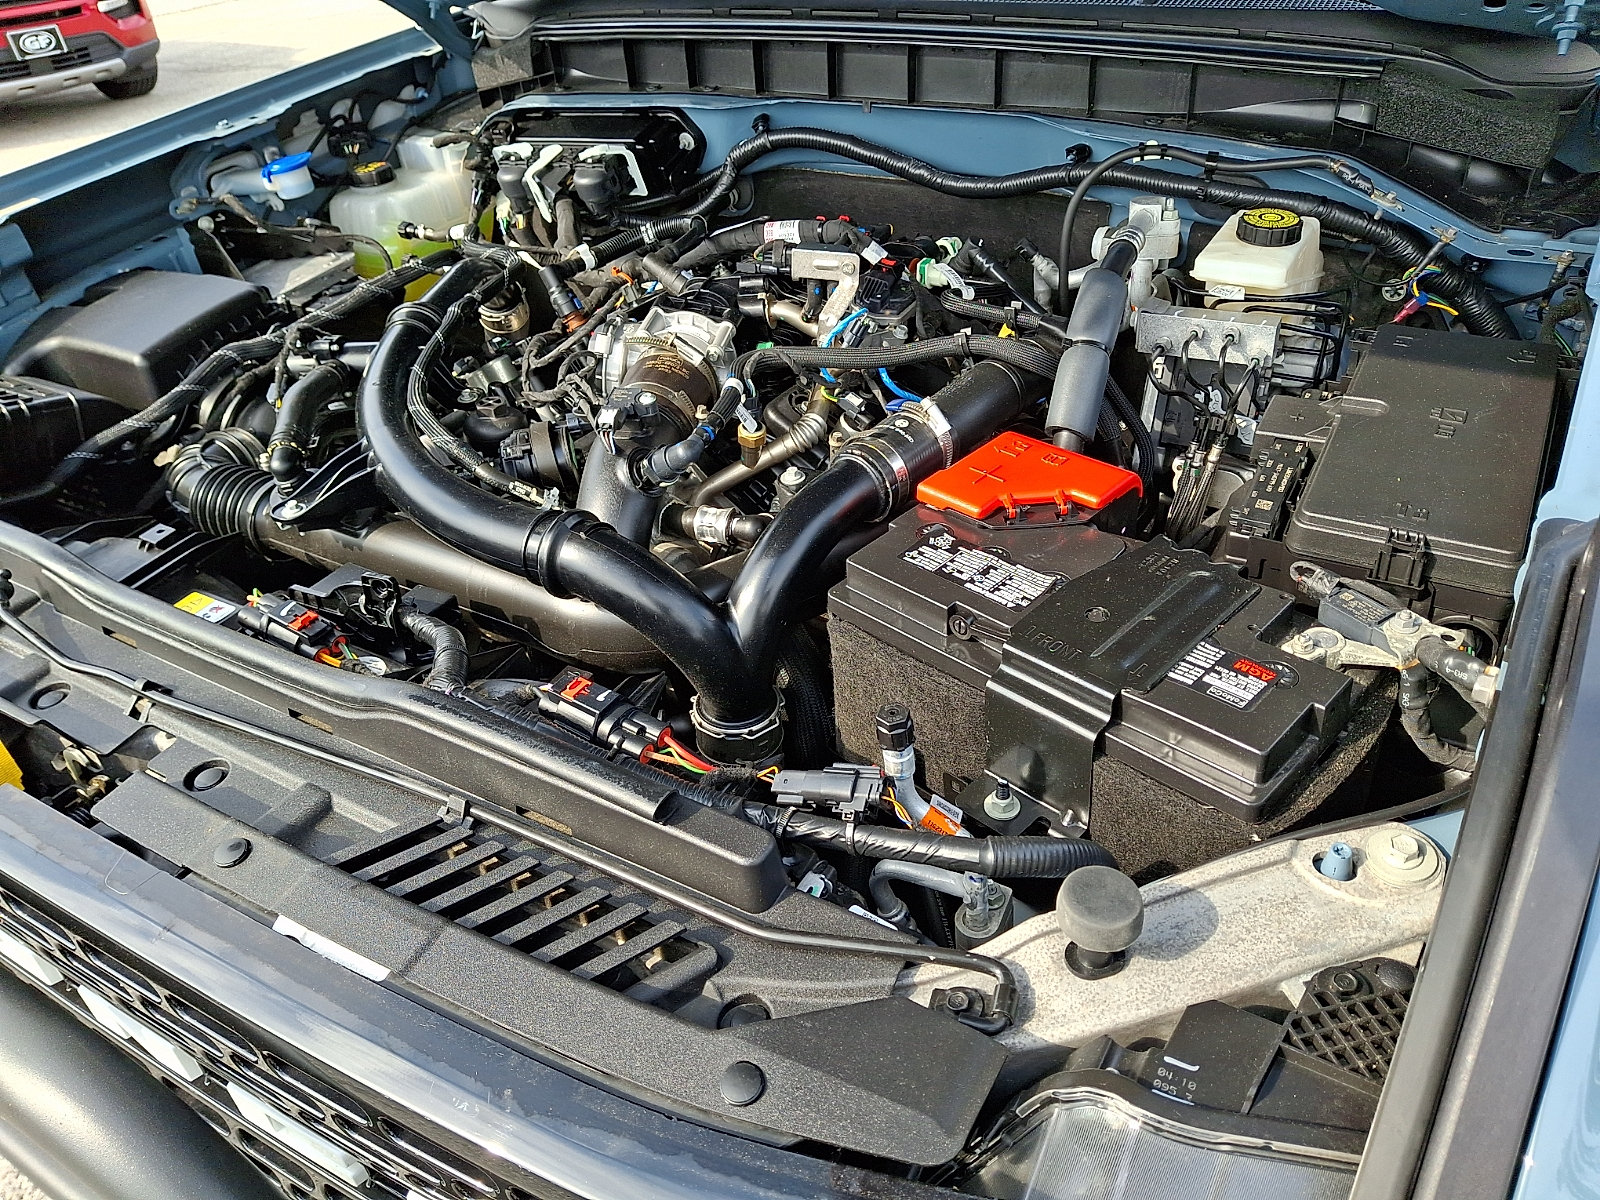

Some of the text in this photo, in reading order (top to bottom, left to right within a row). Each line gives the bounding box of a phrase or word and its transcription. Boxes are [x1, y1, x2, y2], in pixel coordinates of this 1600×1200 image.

[1031, 632, 1083, 661] FRONT
[1233, 661, 1276, 682] AGM
[1210, 687, 1248, 707] FoMoCo
